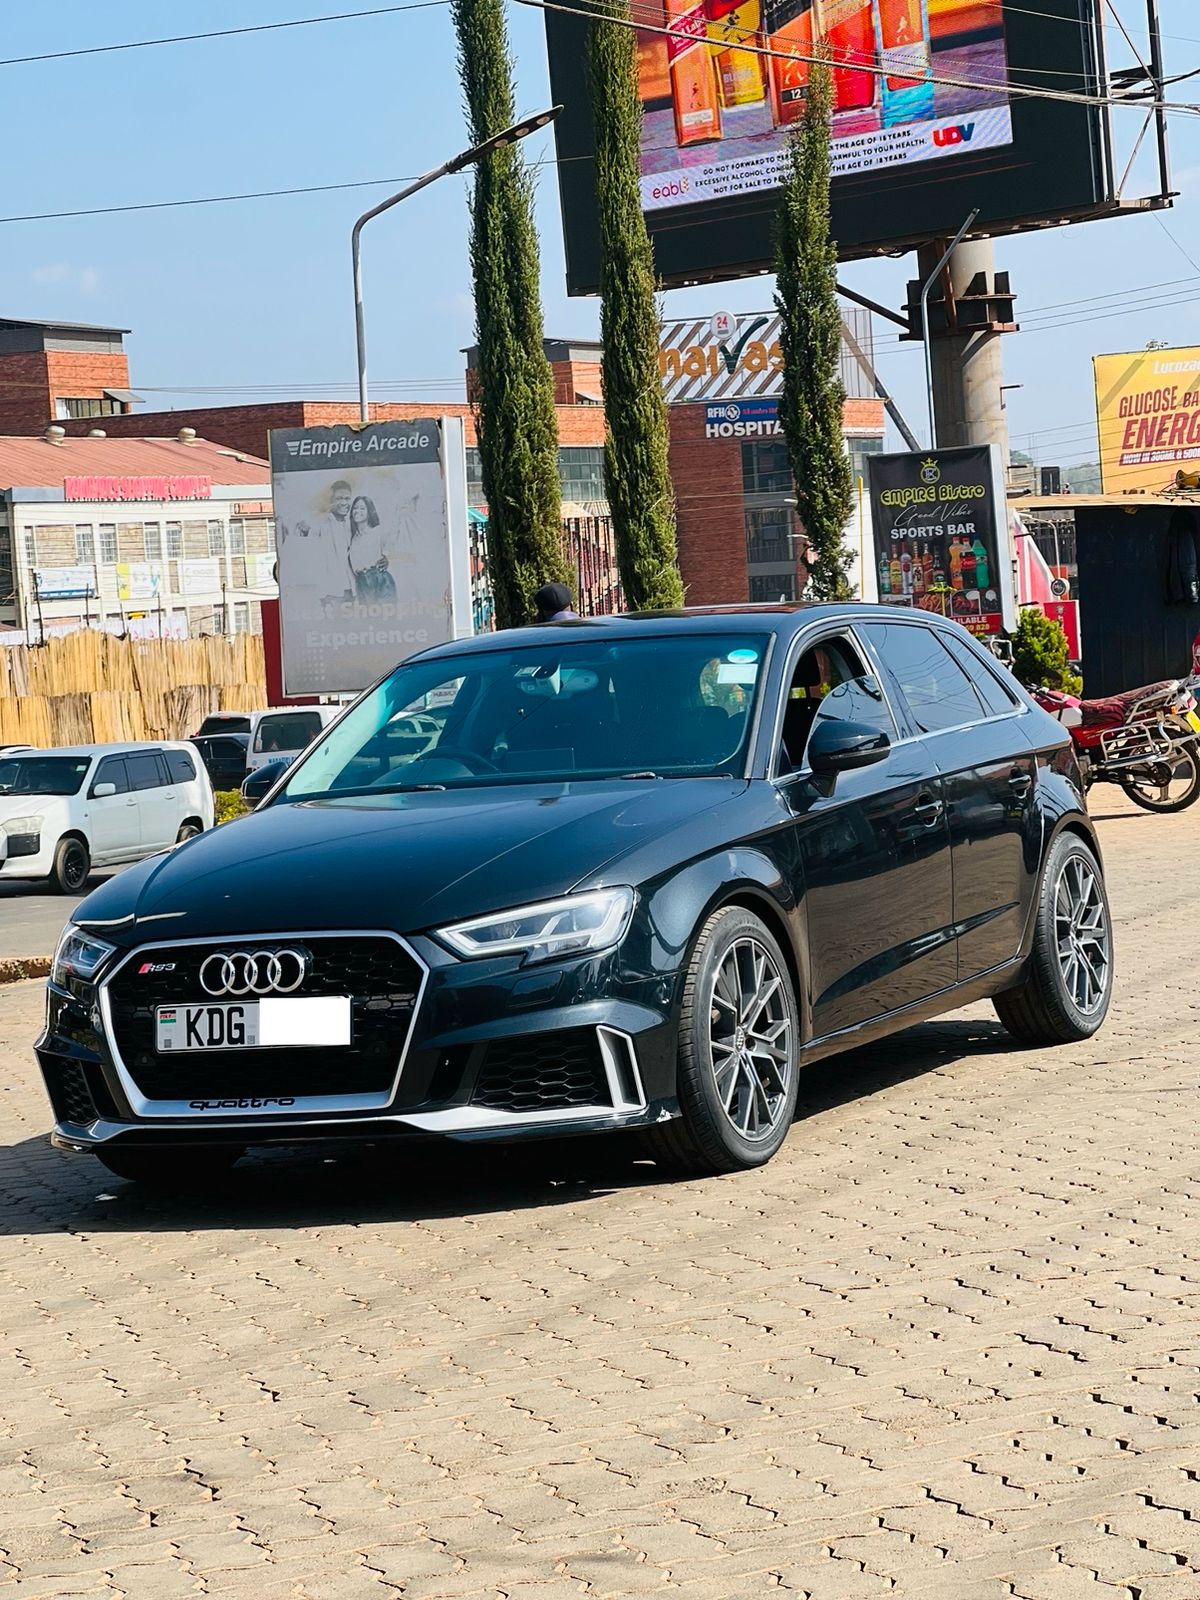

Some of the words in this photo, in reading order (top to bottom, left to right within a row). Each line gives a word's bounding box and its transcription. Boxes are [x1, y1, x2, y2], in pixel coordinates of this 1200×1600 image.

[791, 89, 801, 99] 12
[851, 139, 865, 147] AGE
[933, 123, 974, 147] UDV
[830, 151, 861, 160] ARMFUL
[874, 145, 894, 153] YOUR
[731, 158, 765, 170] FORWARD
[848, 161, 861, 169] AGE
[695, 175, 729, 187] EXCESSIVE
[731, 170, 764, 180] ALCOHOL
[717, 316, 728, 328] 24
[1119, 385, 1178, 418] GLUCOSE
[707, 407, 725, 418] RFH
[706, 420, 785, 438] HOSPITA
[1122, 409, 1200, 449] ENERG
[300, 437, 362, 457] Empire
[366, 432, 430, 451] Arcade
[881, 486, 936, 507] EMPIRE
[939, 484, 985, 500] Bistro
[894, 504, 941, 527] Good
[890, 525, 943, 539] SPORTS
[947, 522, 976, 535] BAR
[305, 626, 428, 649] Experience
[142, 963, 176, 973] RS3
[186, 1007, 245, 1047] KDG
[189, 1097, 296, 1111] quattro
